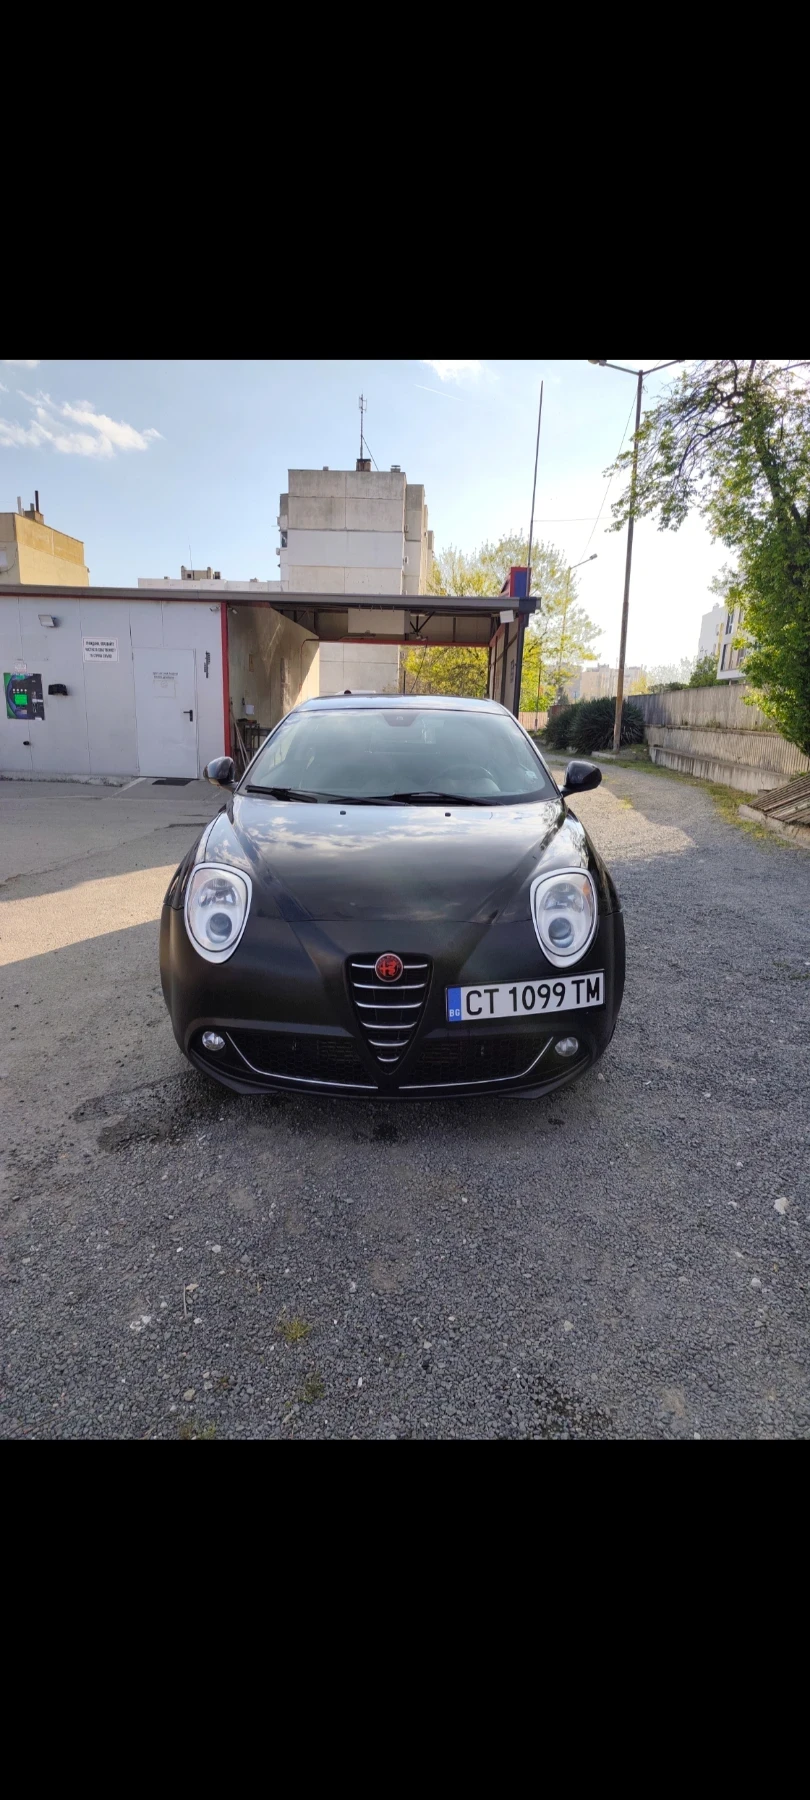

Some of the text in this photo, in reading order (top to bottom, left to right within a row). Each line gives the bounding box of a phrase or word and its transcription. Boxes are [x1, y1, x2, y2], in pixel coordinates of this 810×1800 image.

[466, 977, 600, 1016] CT 1099 TM
[449, 1008, 461, 1017] BG
